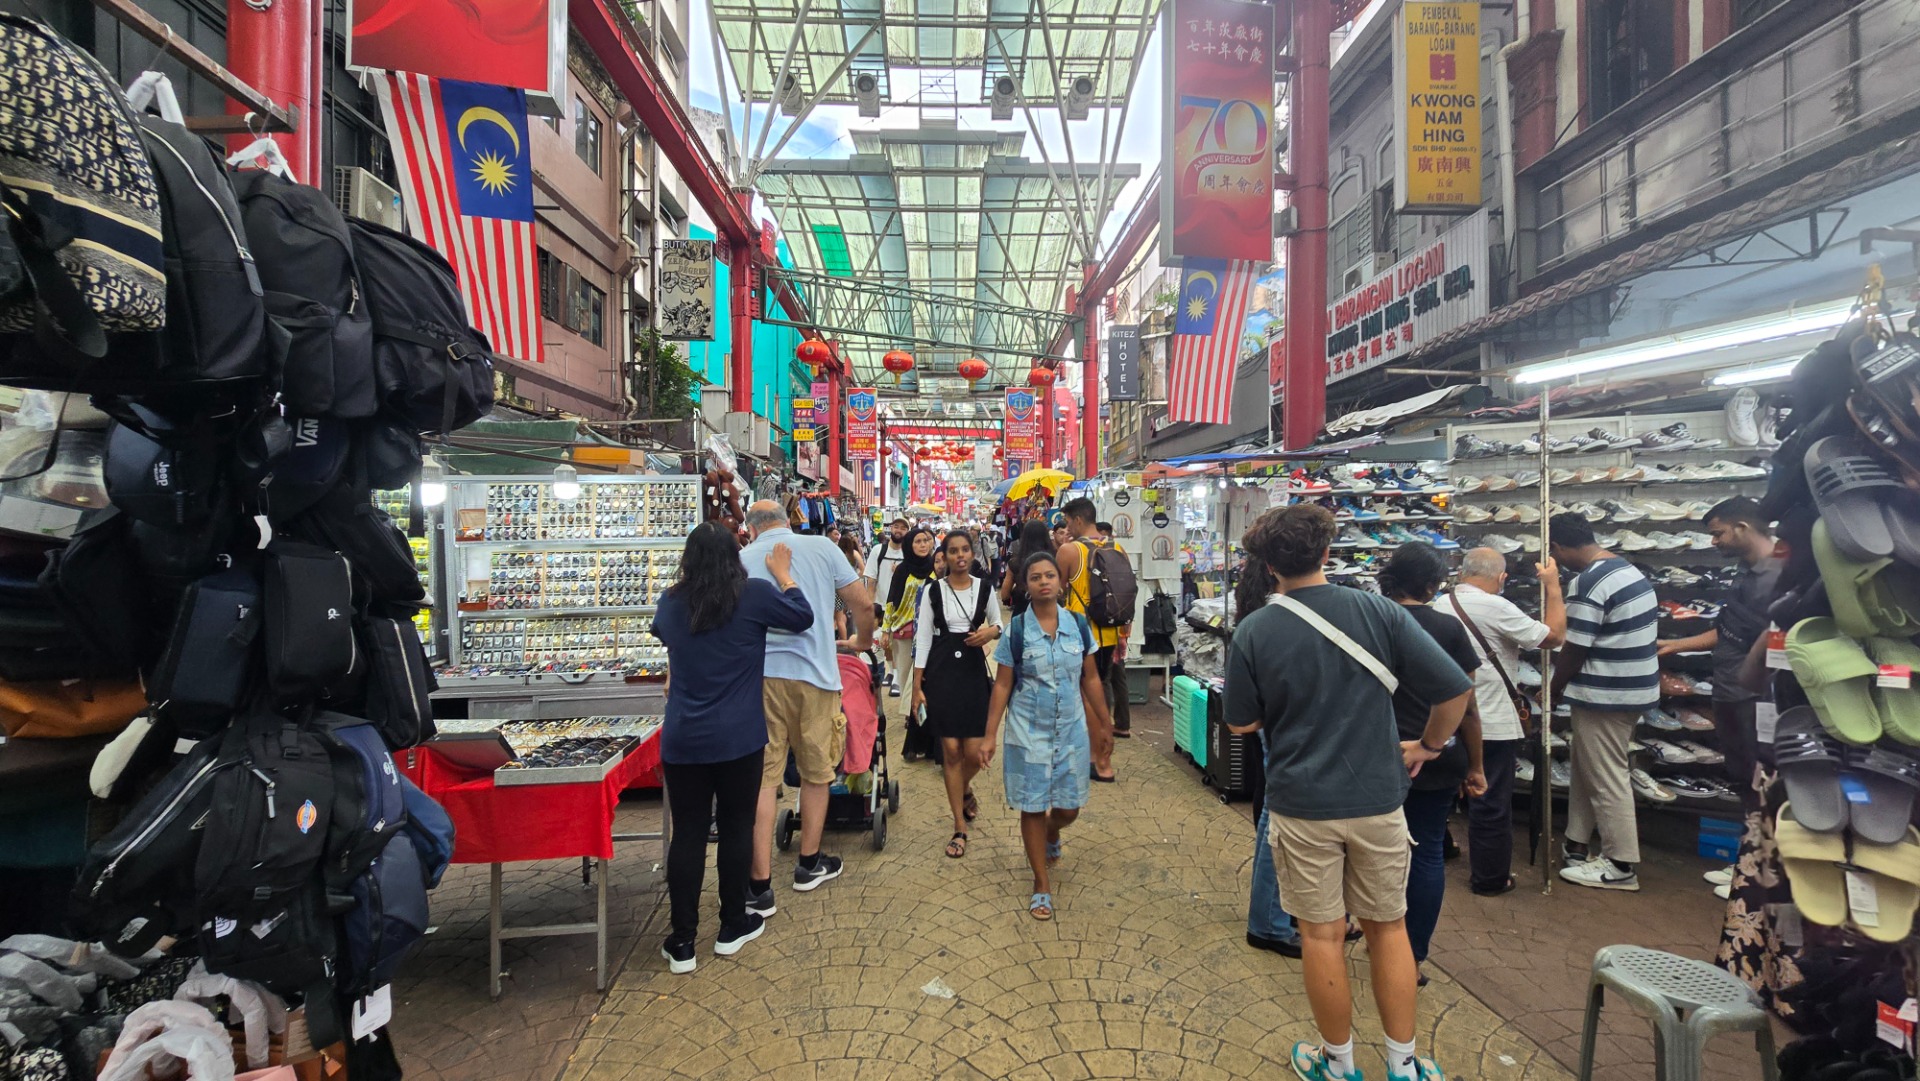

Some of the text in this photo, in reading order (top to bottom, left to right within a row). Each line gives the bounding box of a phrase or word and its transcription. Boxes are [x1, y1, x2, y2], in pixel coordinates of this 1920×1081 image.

[1422, 7, 1462, 20] PEMBEKAL
[1409, 22, 1476, 36] BARANG-BARANG
[1429, 38, 1455, 51] LOGAM
[1411, 94, 1475, 108] KWONG
[1425, 111, 1462, 124] NAM
[1180, 95, 1267, 155] 70
[1423, 129, 1465, 142] HING
[1194, 154, 1252, 171] ANNIVERSARY
[1417, 156, 1472, 174] 廣南興
[1436, 178, 1453, 188] 五金
[1427, 192, 1464, 202] 有限公司
[663, 240, 688, 249] BUTIK
[1335, 274, 1394, 331] BARANGAN
[1398, 242, 1445, 297] LOGAM
[1112, 330, 1135, 338] KITEZ
[1119, 341, 1128, 394] HOTEL
[295, 418, 319, 447] VAN
[159, 461, 170, 487] Jeep
